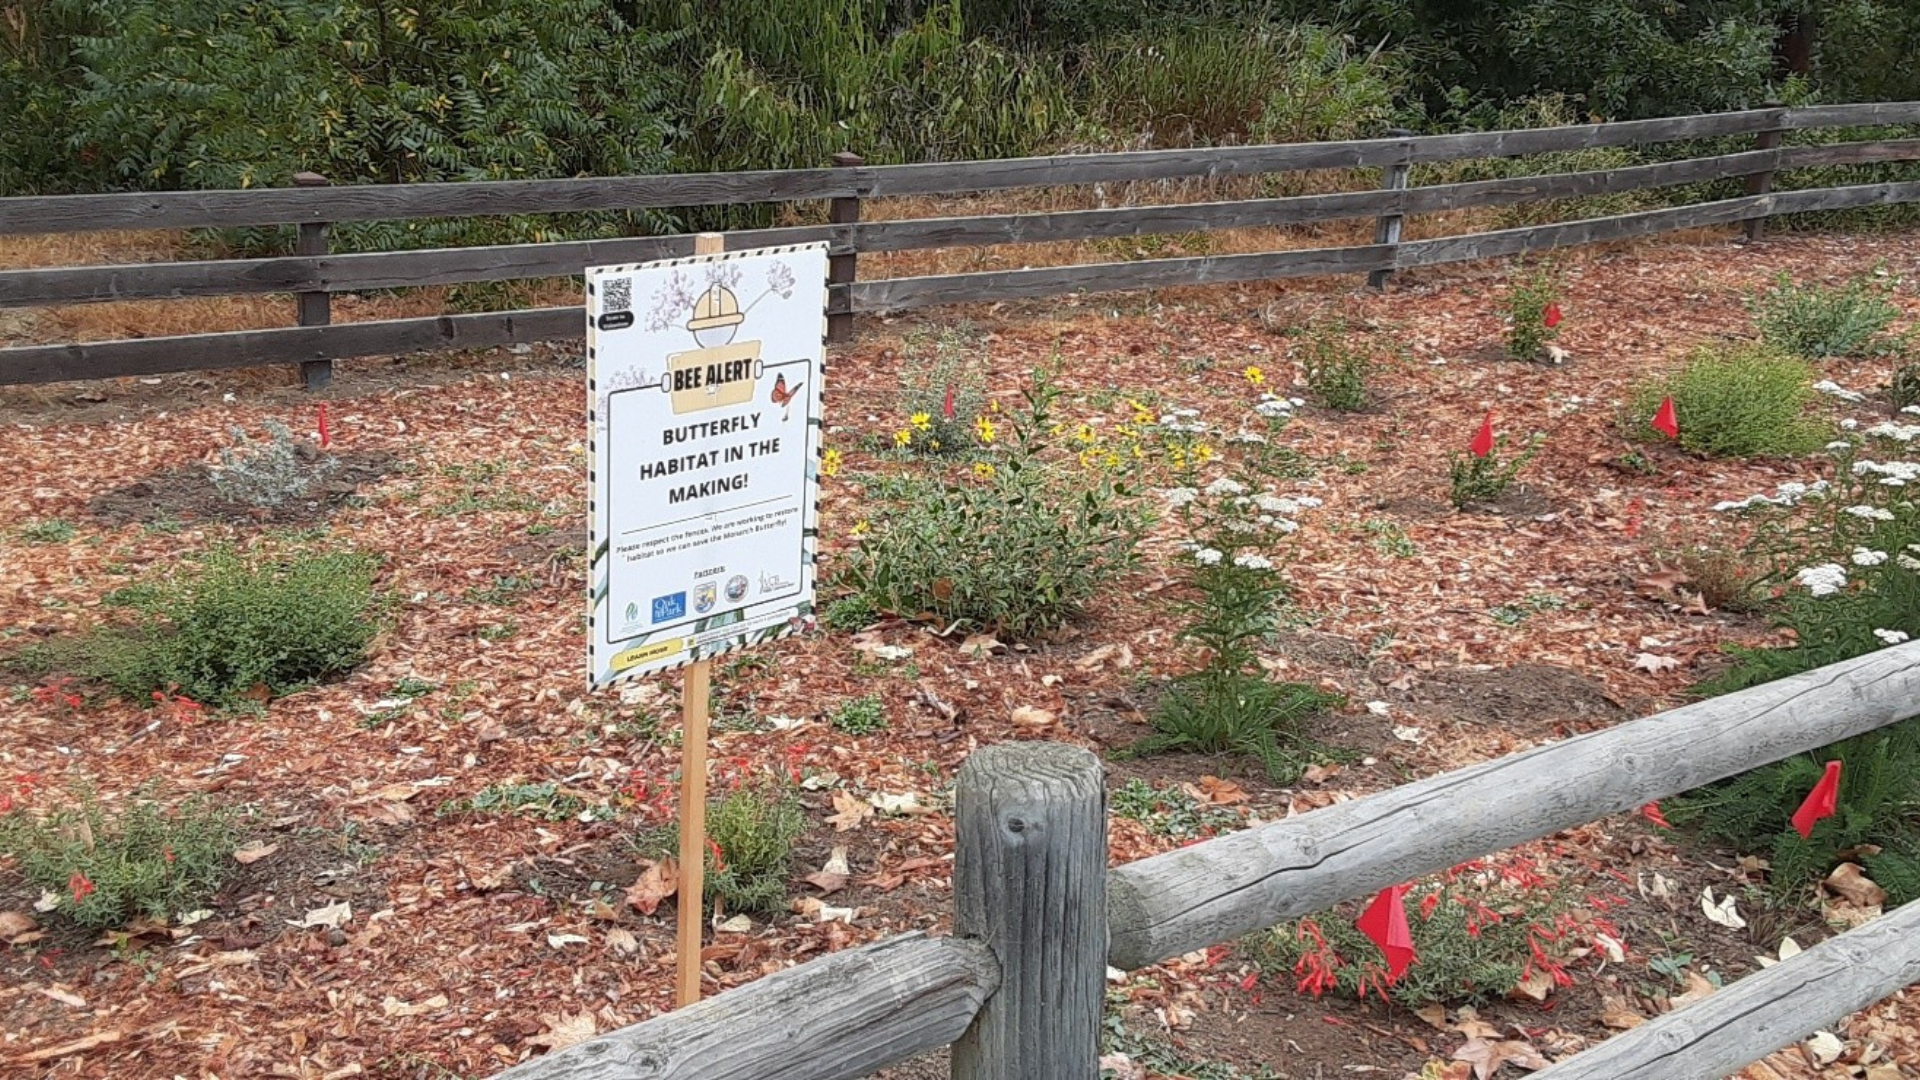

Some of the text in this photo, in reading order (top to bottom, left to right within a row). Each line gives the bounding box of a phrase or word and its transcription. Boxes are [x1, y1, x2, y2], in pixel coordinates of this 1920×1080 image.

[674, 358, 752, 391] BEE ALERT
[663, 412, 761, 445] BUTTERFLY
[640, 438, 780, 480] HABITAT IN THE
[669, 473, 748, 504] MAKING!
[616, 543, 640, 553] Please
[641, 537, 670, 547] respect
[711, 524, 723, 532] We
[723, 521, 736, 529] are
[736, 514, 765, 525] working
[774, 507, 798, 517] restore
[627, 551, 654, 562] habitat
[678, 542, 691, 550] can
[692, 538, 709, 547] save
[710, 534, 722, 542] the
[723, 527, 754, 539] Monarch
[755, 519, 788, 532] Butterfly!
[627, 652, 649, 662] LEARN
